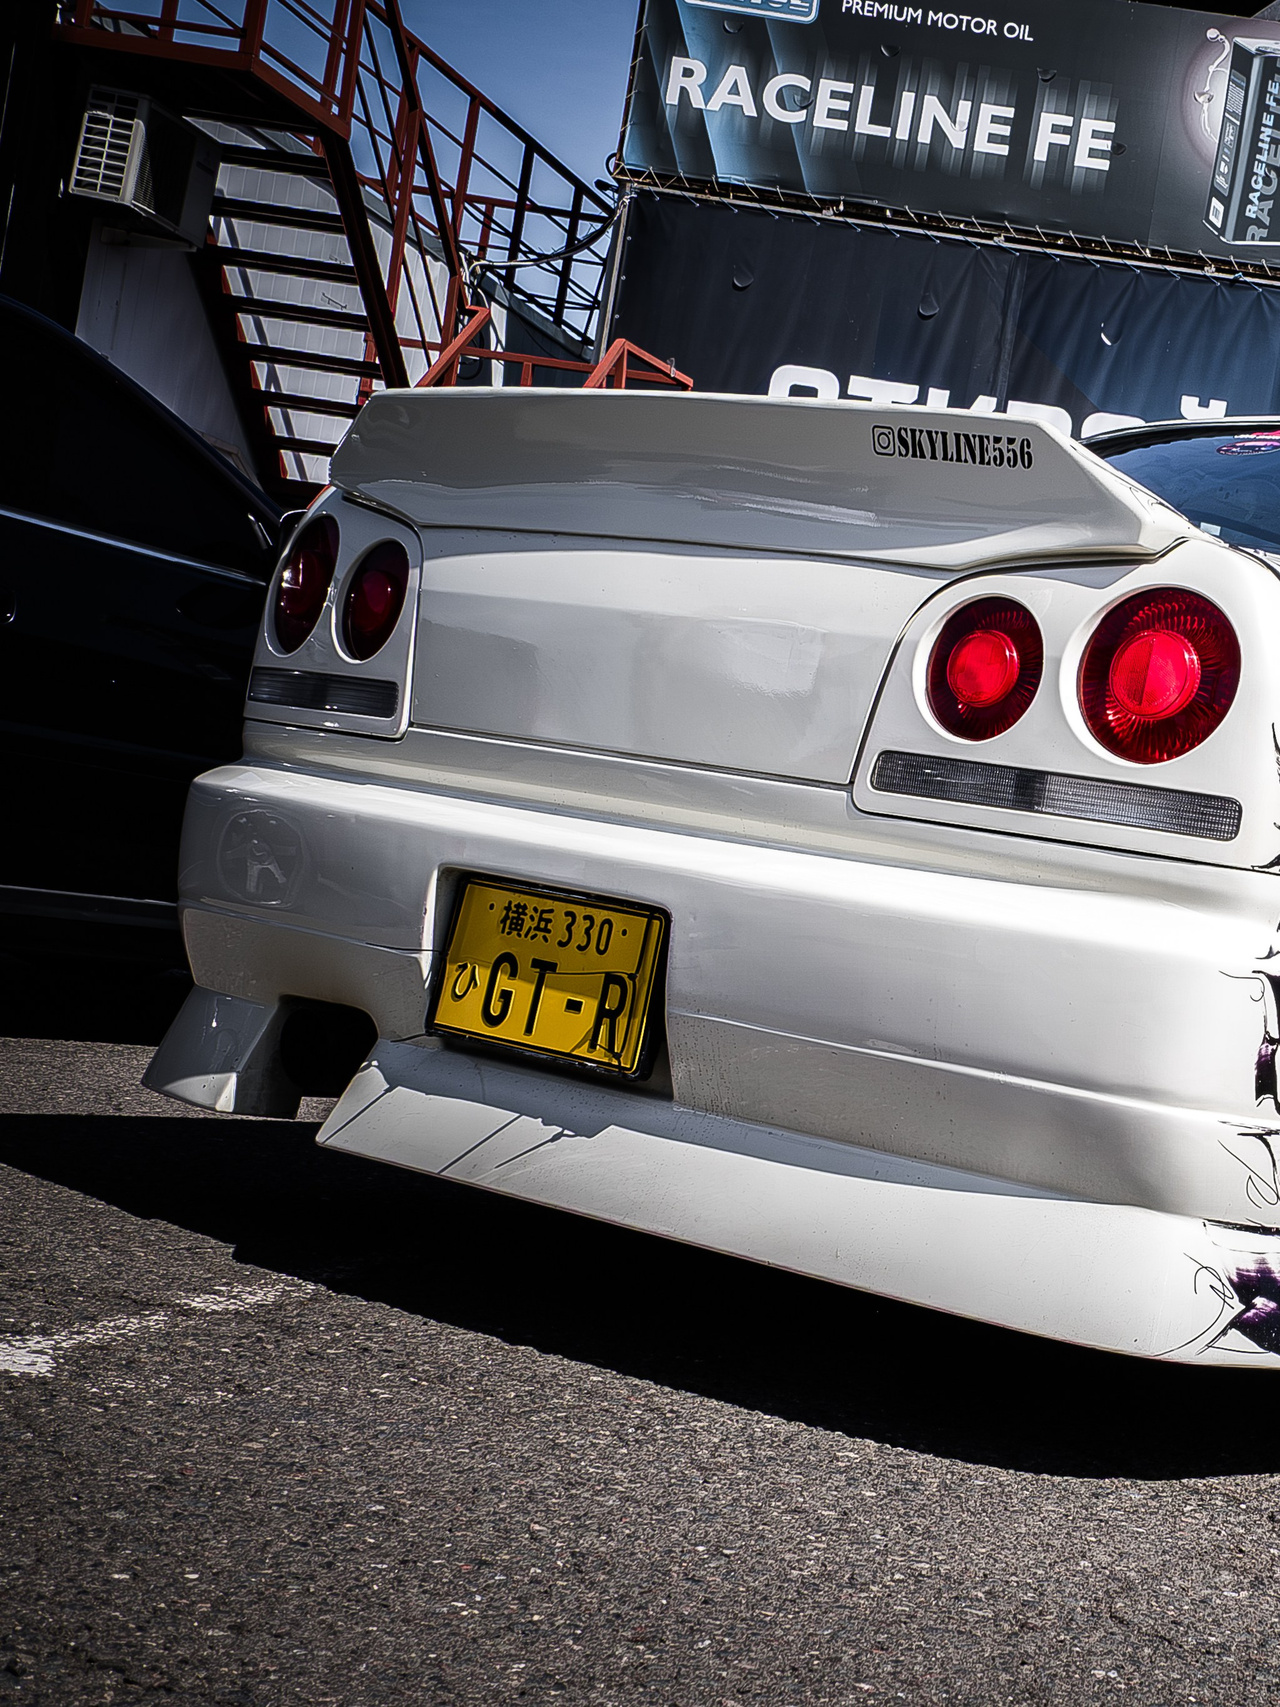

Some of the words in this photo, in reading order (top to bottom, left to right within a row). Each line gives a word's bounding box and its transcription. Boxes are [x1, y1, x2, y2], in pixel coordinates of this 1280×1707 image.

[842, 0, 922, 25] PREMIUM
[927, 10, 998, 36] MOTOR
[1003, 22, 1034, 42] OIL
[665, 56, 1015, 156] RACELINE
[1033, 111, 1116, 170] FE
[1245, 111, 1275, 219] RACELINE
[897, 426, 1033, 470] SKYLINE556
[500, 900, 555, 944] 横浜
[556, 910, 614, 956] 330
[451, 962, 480, 1002] ひ
[481, 951, 629, 1060] GT-R
